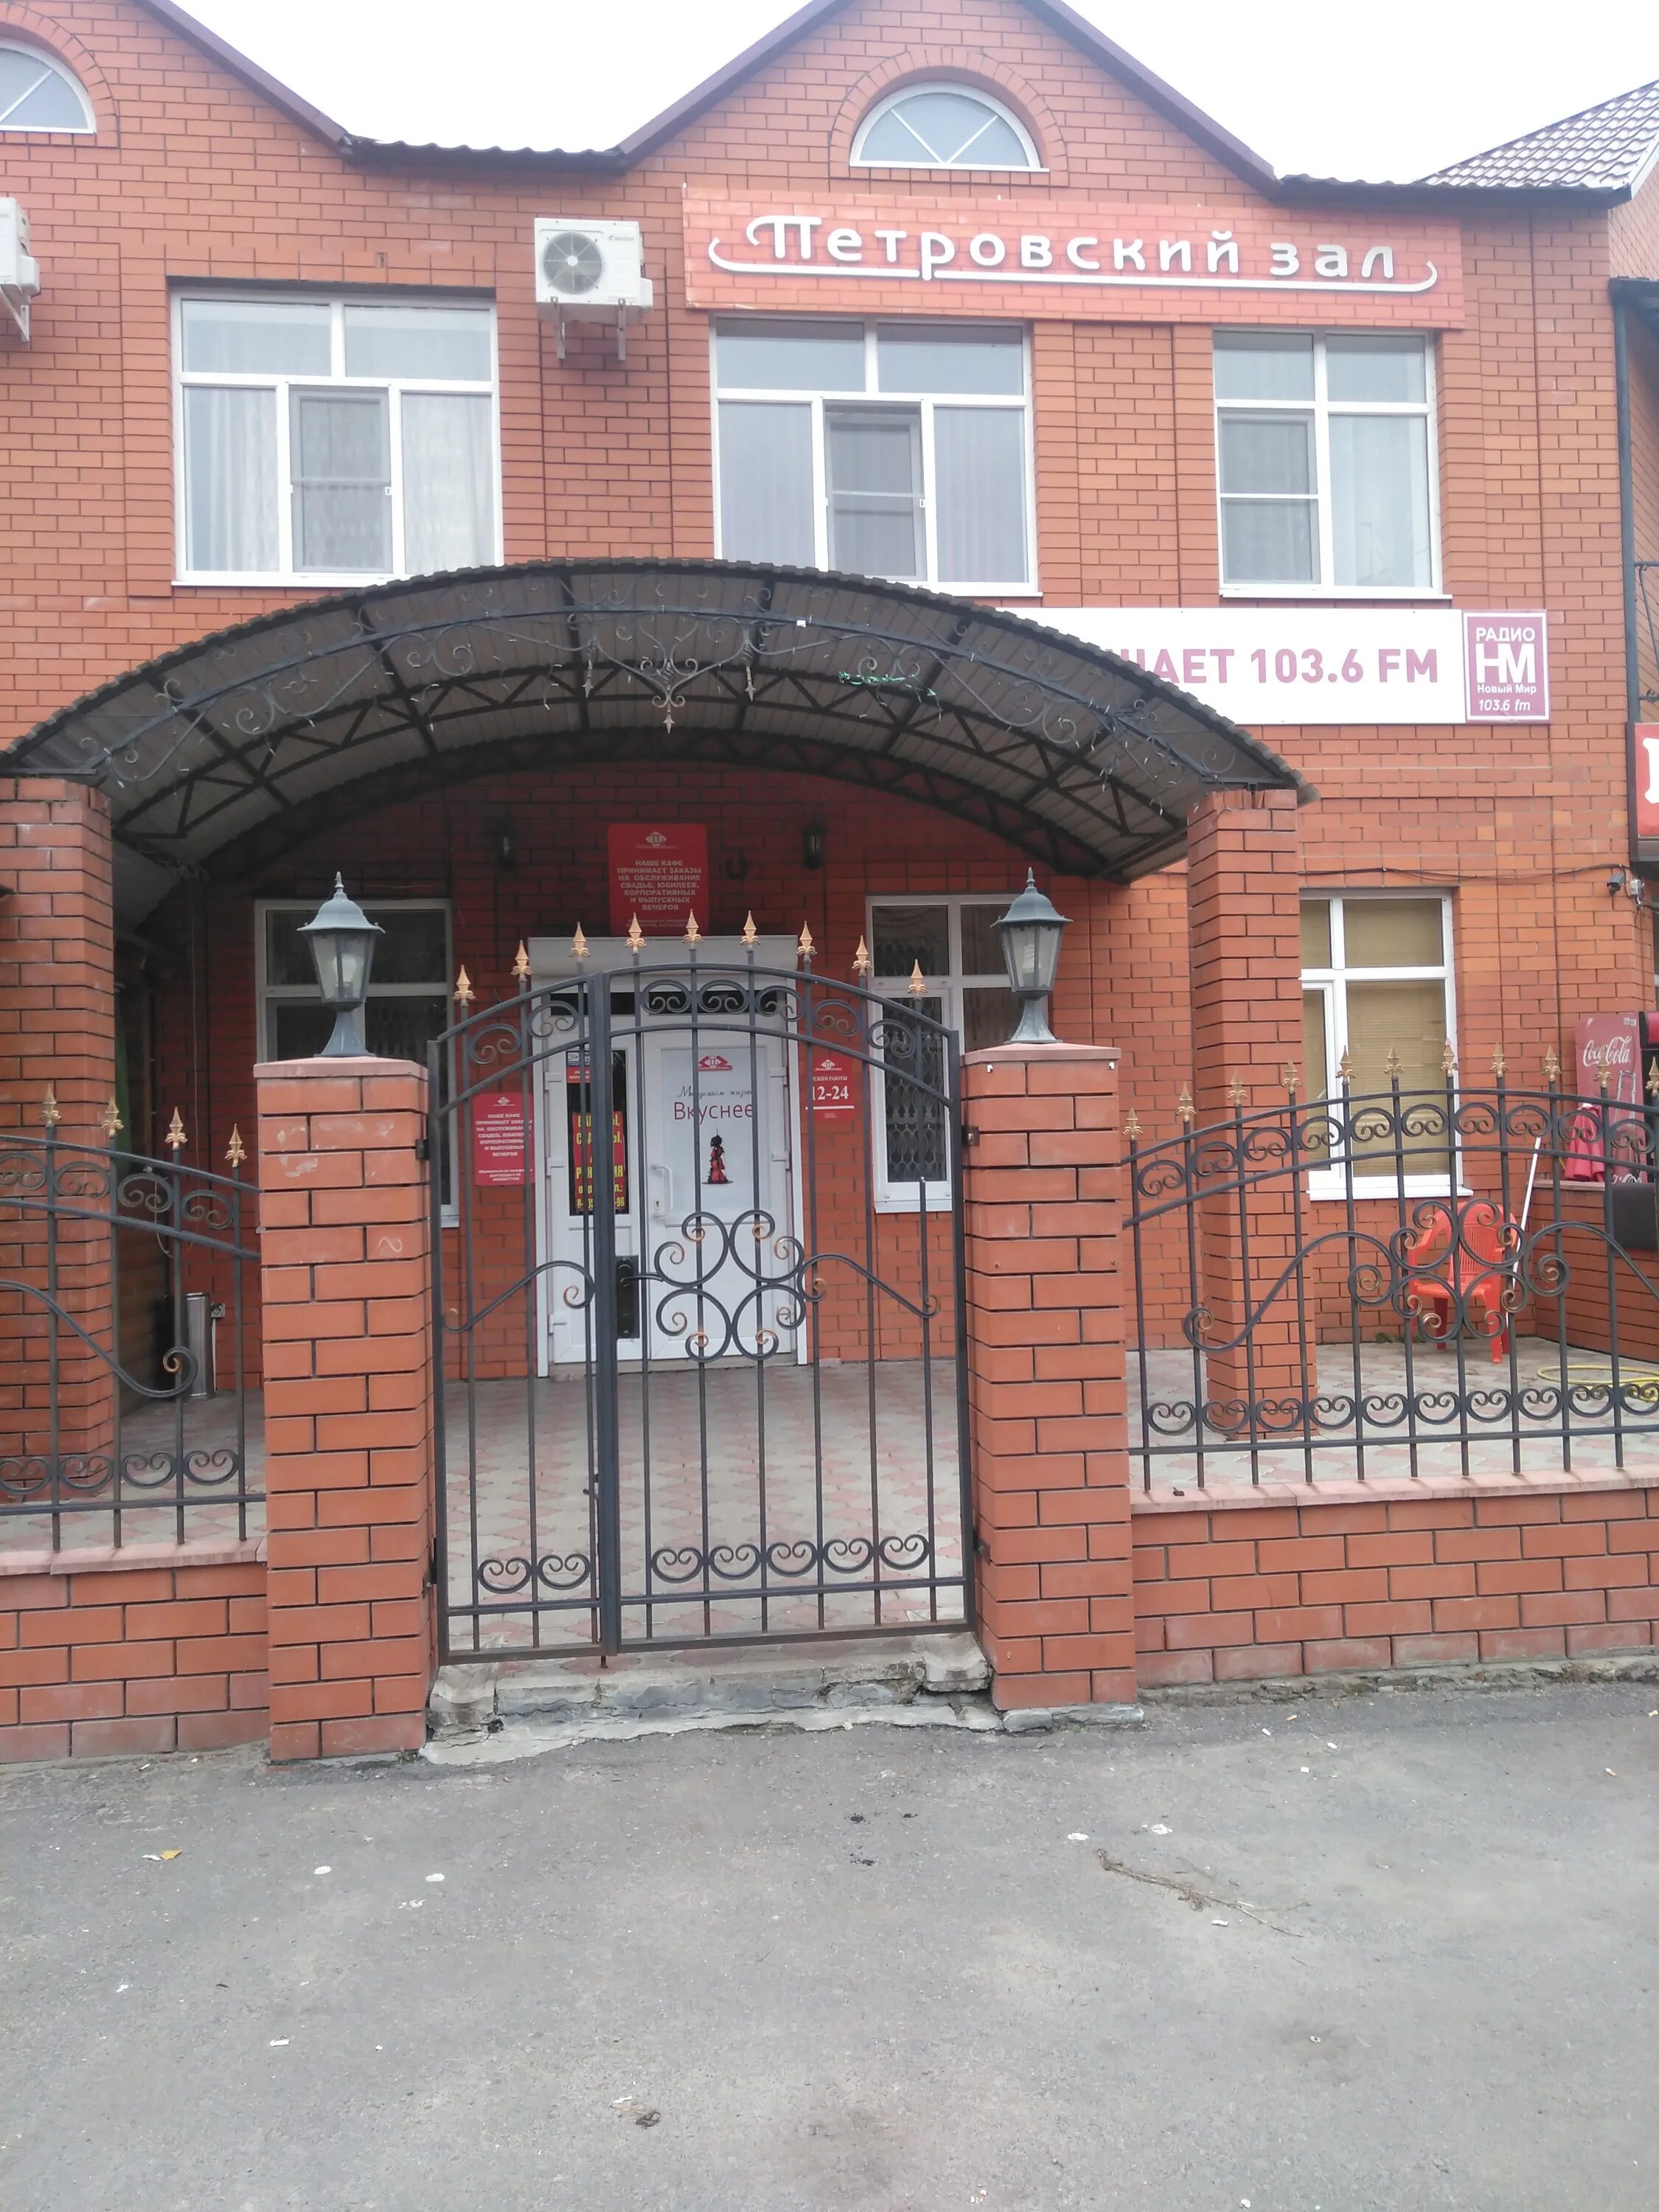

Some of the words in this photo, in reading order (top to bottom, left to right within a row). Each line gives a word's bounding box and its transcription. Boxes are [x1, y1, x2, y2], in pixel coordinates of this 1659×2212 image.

[746, 215, 1240, 279] Петровский
[1268, 244, 1394, 279] зал
[1475, 627, 1537, 641] РАДИО
[1250, 648, 1364, 684] 103.6
[1378, 649, 1439, 684] FM
[1475, 643, 1536, 684] НМ
[1477, 684, 1512, 693] Новый
[1515, 684, 1537, 695] Мир
[1478, 699, 1511, 712] 103.6
[1514, 698, 1531, 712] fm
[812, 1085, 849, 1101] 12-24
[673, 1102, 753, 1125] Вкуснее
